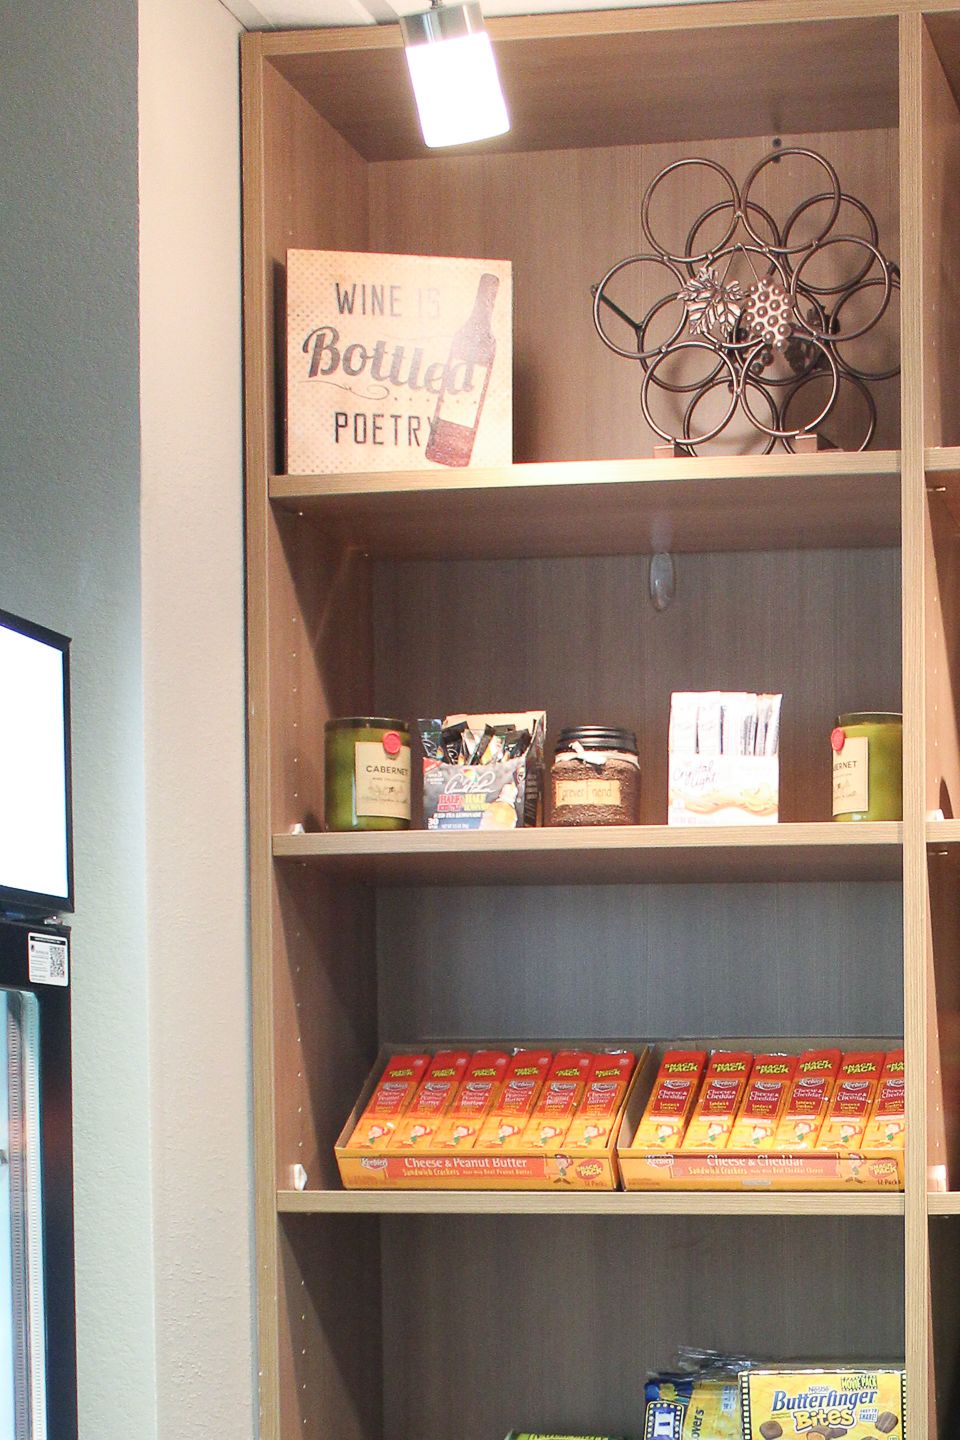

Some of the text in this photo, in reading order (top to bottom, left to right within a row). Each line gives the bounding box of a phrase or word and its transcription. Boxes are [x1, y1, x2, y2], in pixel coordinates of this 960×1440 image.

[334, 282, 402, 318] WINE
[302, 325, 476, 396] Bottled
[334, 411, 439, 447] POETRY
[405, 1157, 527, 1168] Cheese & Peanut Butter
[707, 1154, 804, 1167] Cheese & Cheddar
[772, 1390, 877, 1411] Butterfinger
[652, 1410, 675, 1438] II
[793, 1408, 855, 1432] Bites
